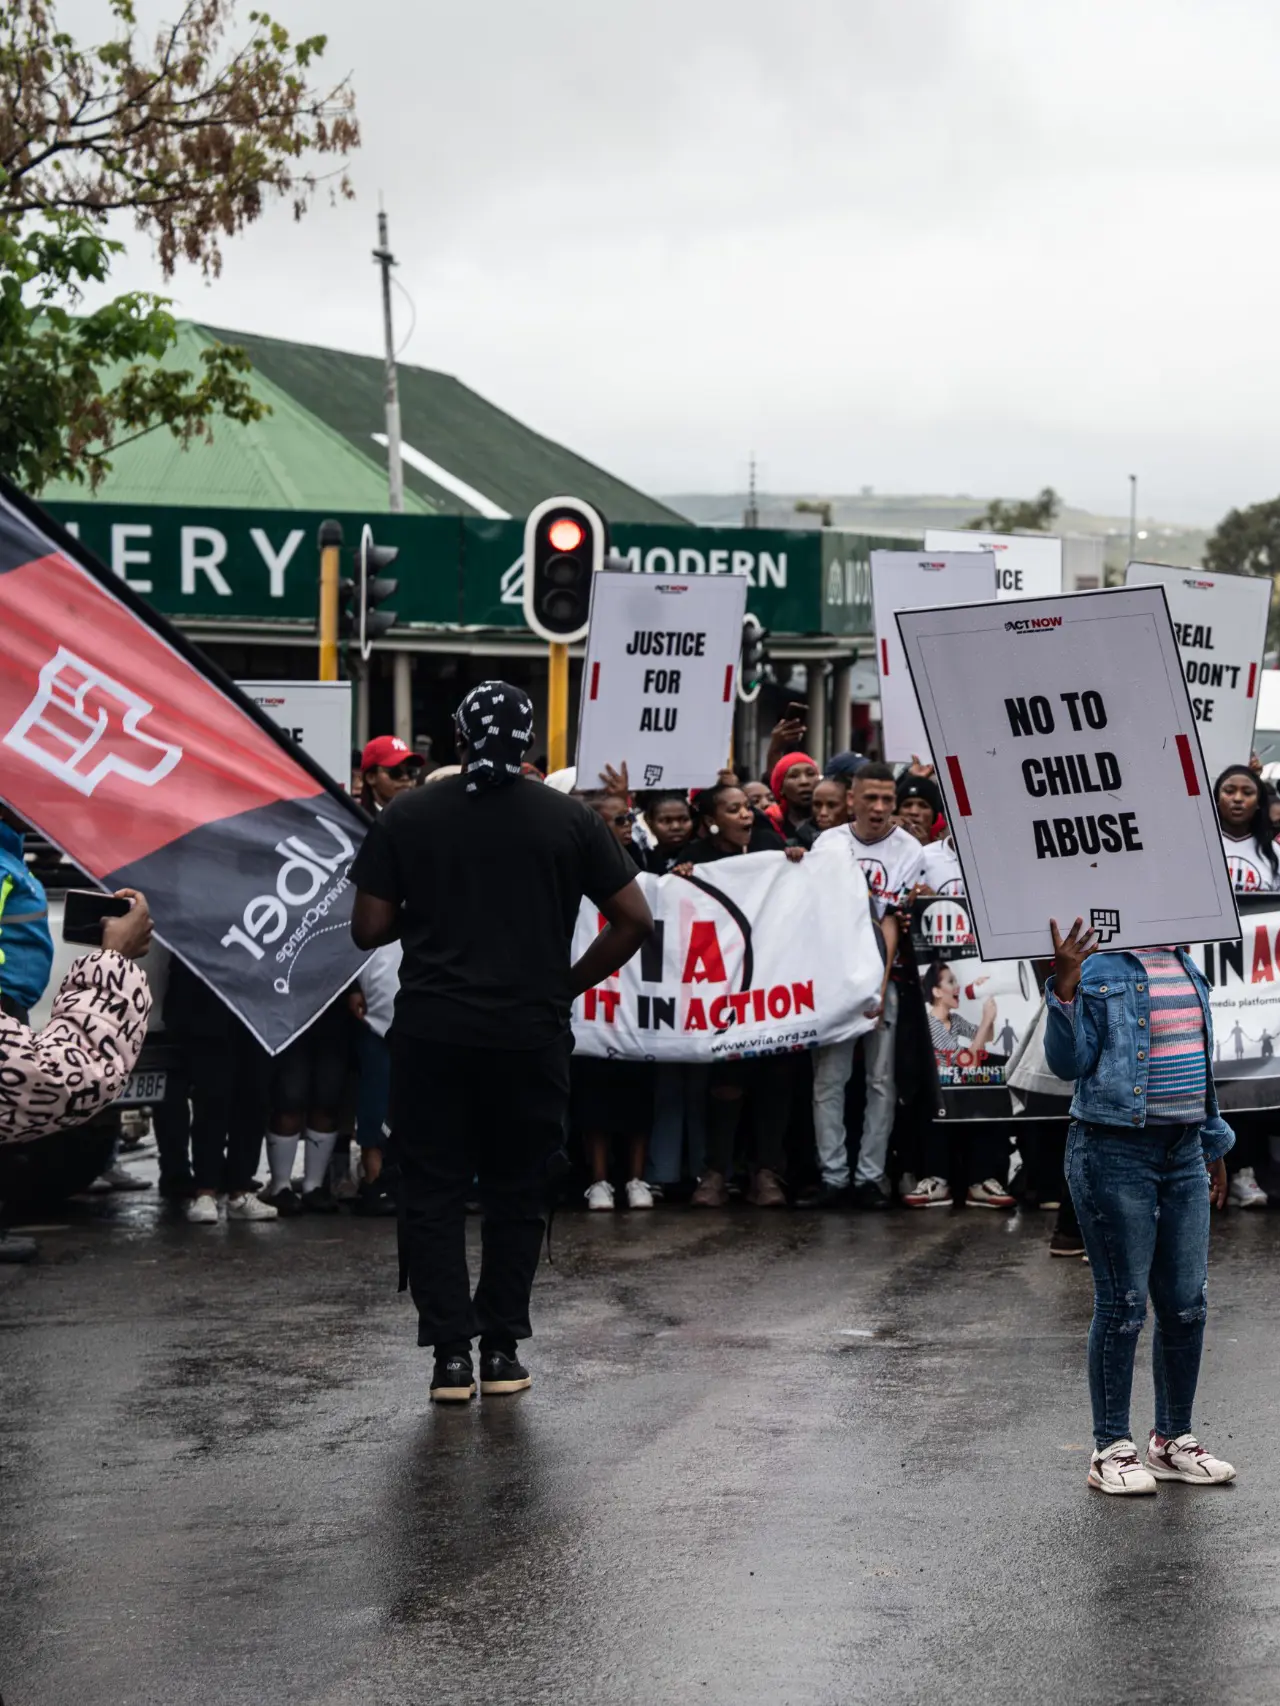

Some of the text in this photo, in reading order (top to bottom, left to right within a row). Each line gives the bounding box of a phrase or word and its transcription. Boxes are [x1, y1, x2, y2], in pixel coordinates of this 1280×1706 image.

[65, 522, 305, 597] ERY
[1004, 620, 1030, 632] ACT
[1031, 616, 1063, 629] NOW
[626, 631, 706, 657] JUSTICE
[643, 669, 681, 694] FOR
[1186, 661, 1241, 689] DON'T
[639, 707, 677, 732] ALU
[1004, 690, 1108, 737] NO TO
[1021, 751, 1122, 797] CHILD
[1032, 811, 1144, 859] ABUSE
[924, 914, 965, 931] VIIA
[584, 979, 816, 1032] IT IN ACTION
[711, 1028, 818, 1054] www.viia.org.za
[961, 1065, 1006, 1076] AGAINST
